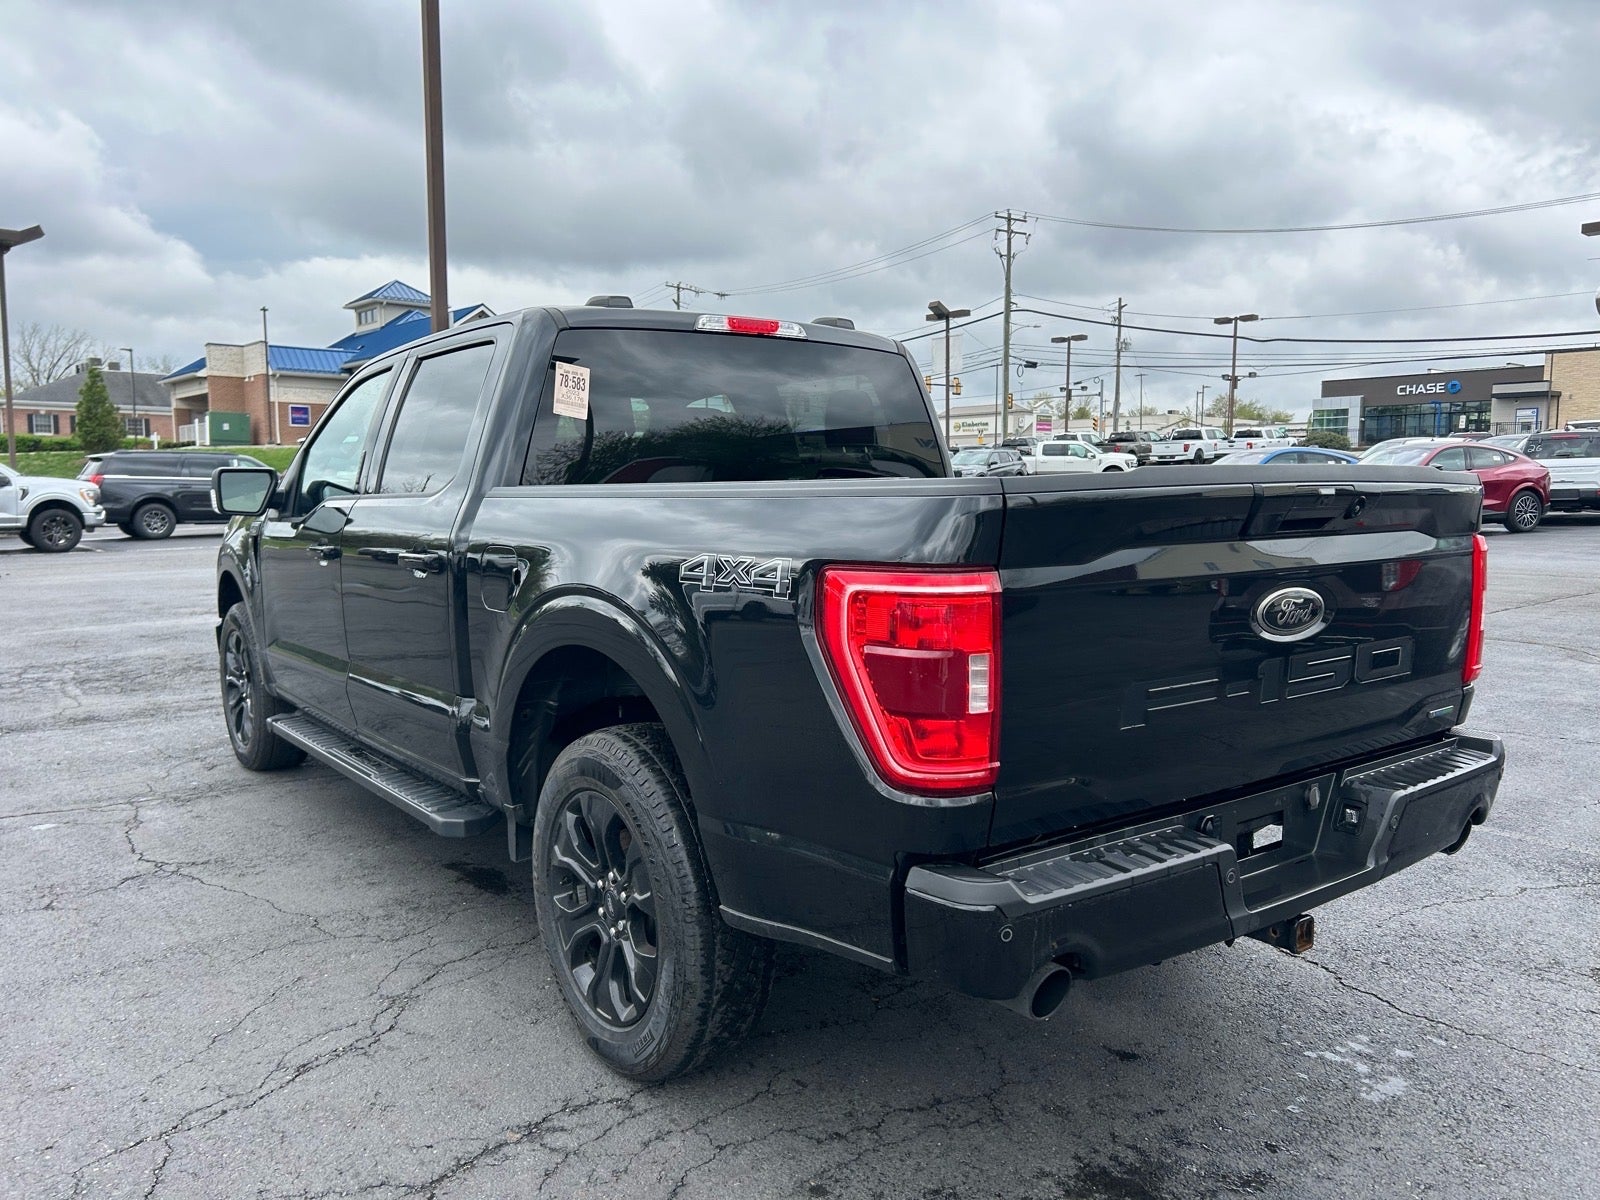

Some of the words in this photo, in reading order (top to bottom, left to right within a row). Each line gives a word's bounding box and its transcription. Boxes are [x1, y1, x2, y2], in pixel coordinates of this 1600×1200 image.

[560, 374, 585, 391] 78:583
[1396, 382, 1445, 396] CHASE
[1527, 444, 1543, 453] 26
[1277, 598, 1313, 625] Ford
[1120, 637, 1414, 730] F-150
